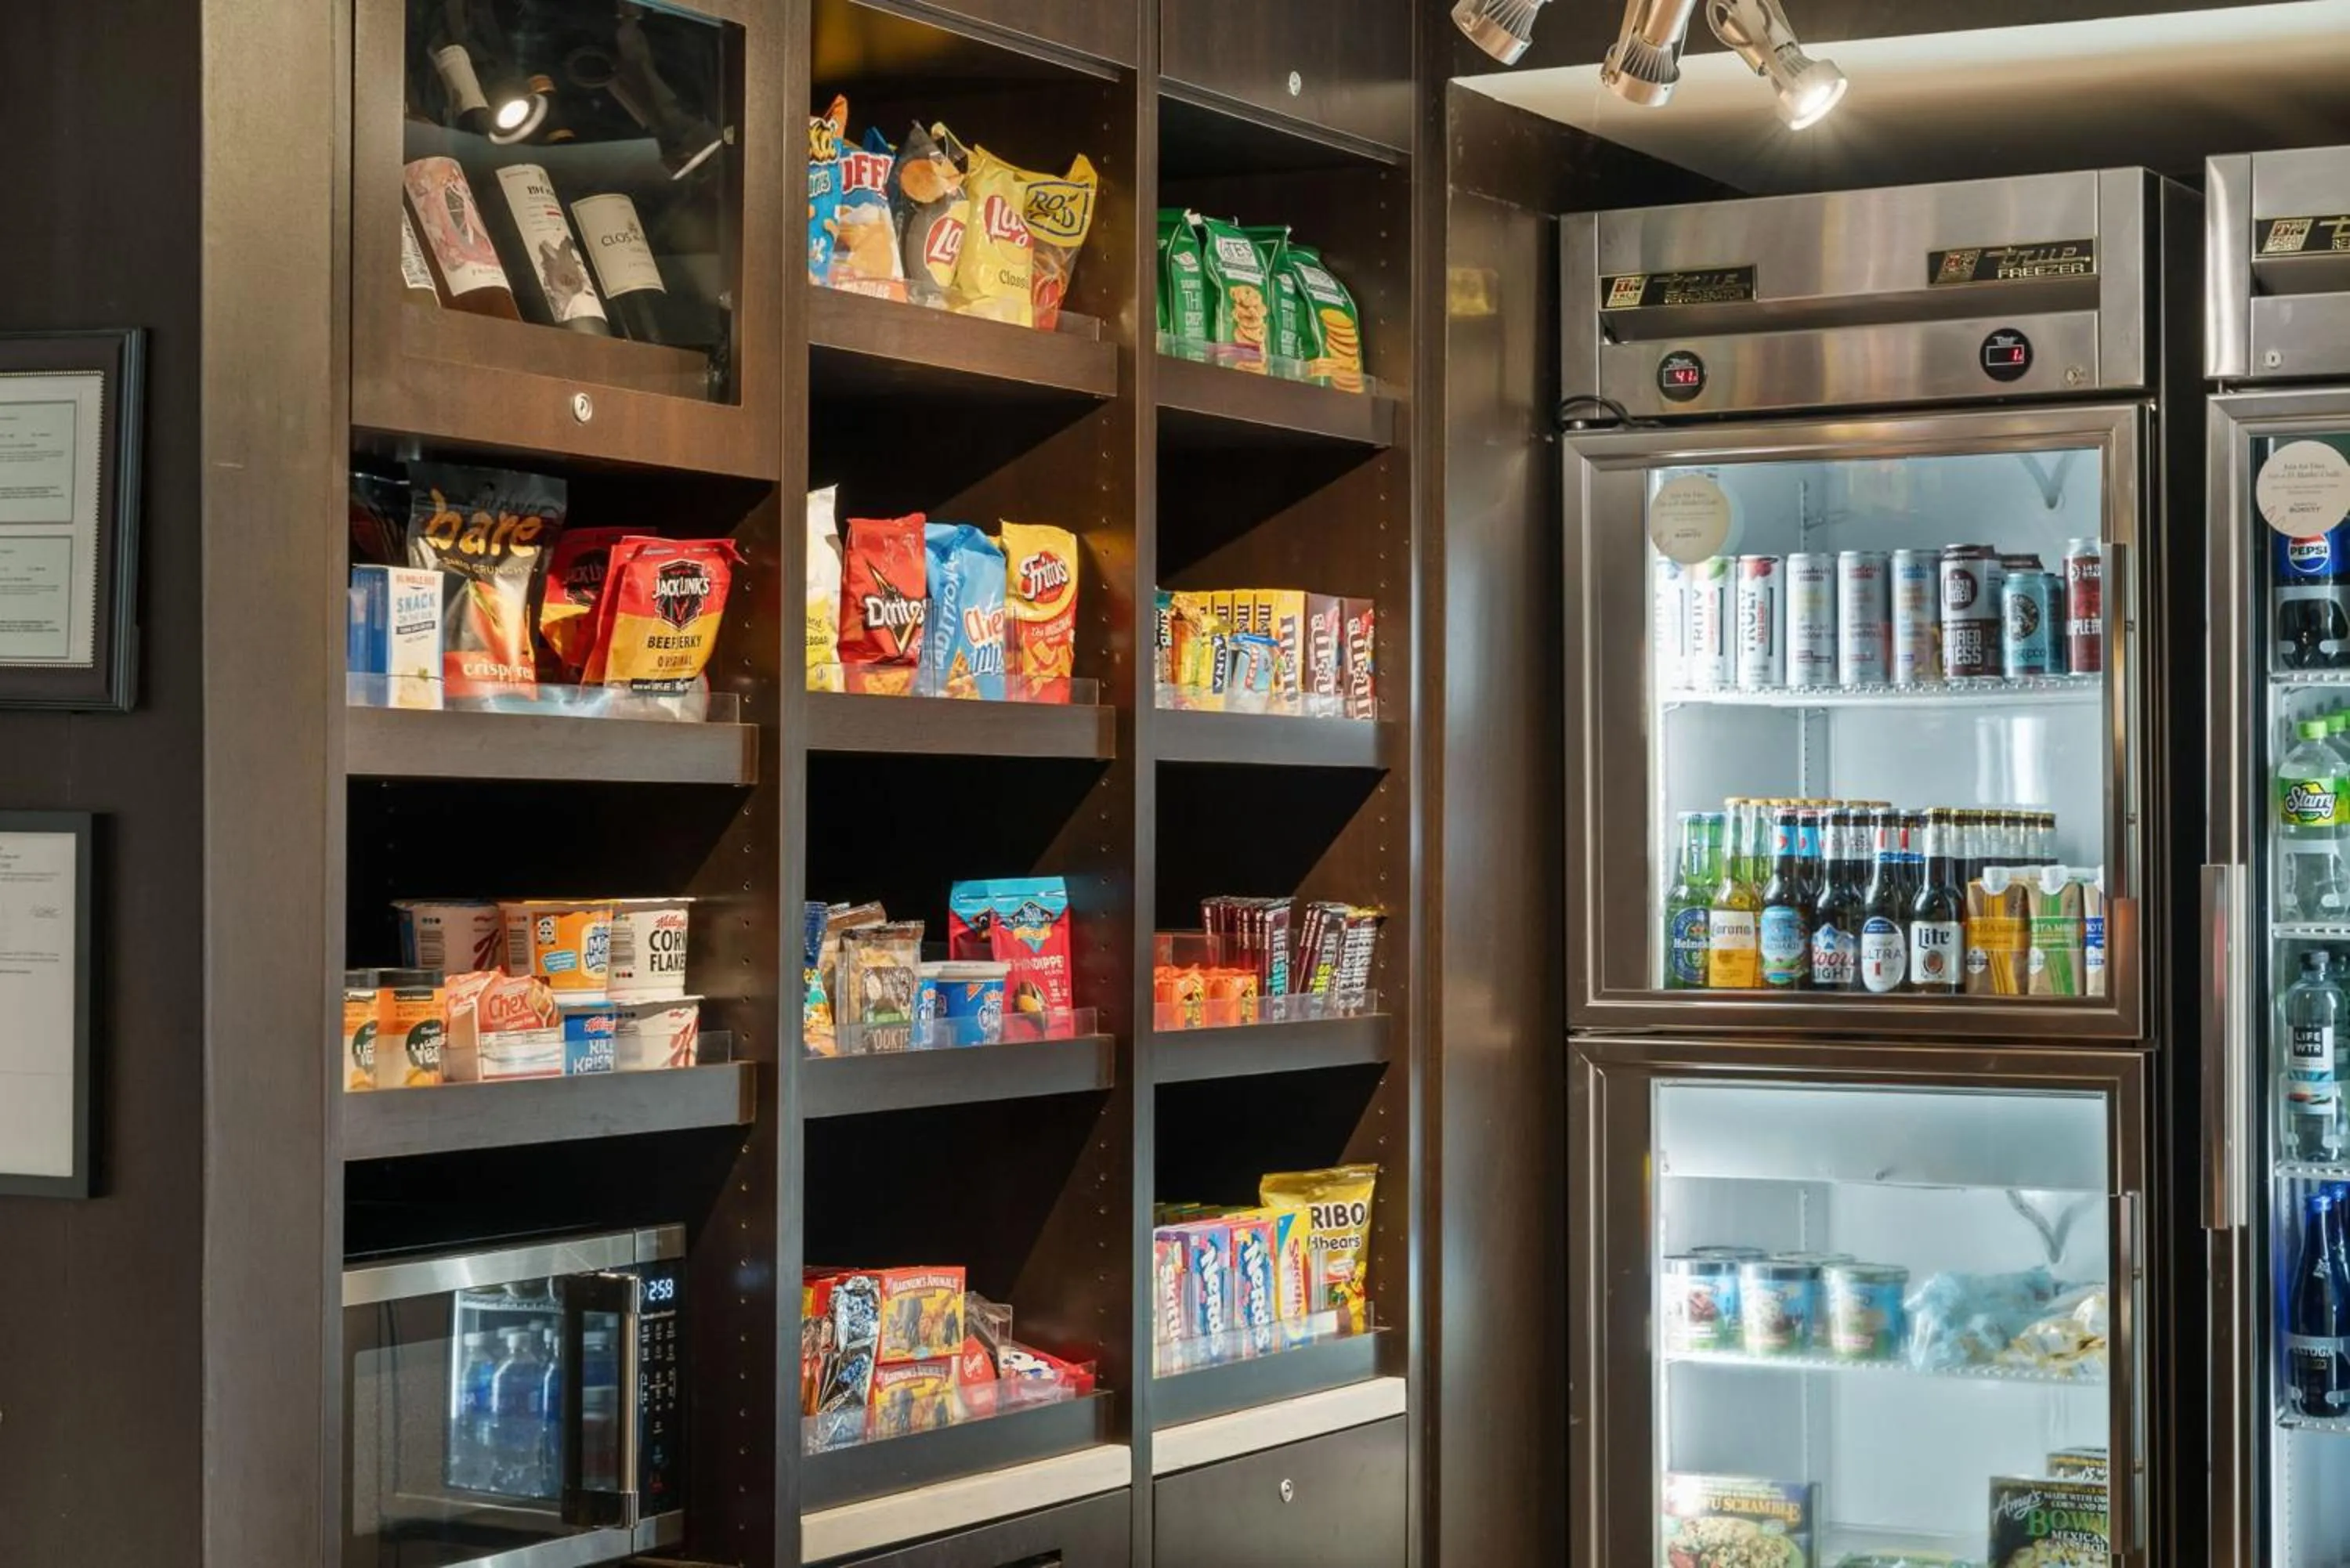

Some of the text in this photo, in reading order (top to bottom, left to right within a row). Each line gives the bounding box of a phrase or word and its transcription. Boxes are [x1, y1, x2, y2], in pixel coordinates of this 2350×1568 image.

[1998, 263, 2084, 280] FREEZER
[425, 488, 543, 558] bare
[2290, 544, 2328, 555] PEPSI
[653, 576, 710, 598] JACK LINK'S
[1019, 551, 1069, 602] Fritos
[396, 592, 436, 612] SNACK
[964, 606, 1005, 647] Che
[647, 634, 702, 649] BEEF JERKY
[2286, 786, 2337, 818] Starry
[1918, 927, 1950, 950] Lite
[650, 953, 685, 972] FLAKE
[489, 992, 529, 1020] Chex
[2295, 1031, 2321, 1042] LIFE
[2295, 1043, 2322, 1053] WTR
[1310, 1202, 1365, 1230] RIBO
[1199, 1246, 1224, 1356] Nerds
[1242, 1240, 1271, 1349] Nerds
[1724, 1497, 1802, 1524] SCRAMBLE
[1992, 1490, 2044, 1525] Amy's
